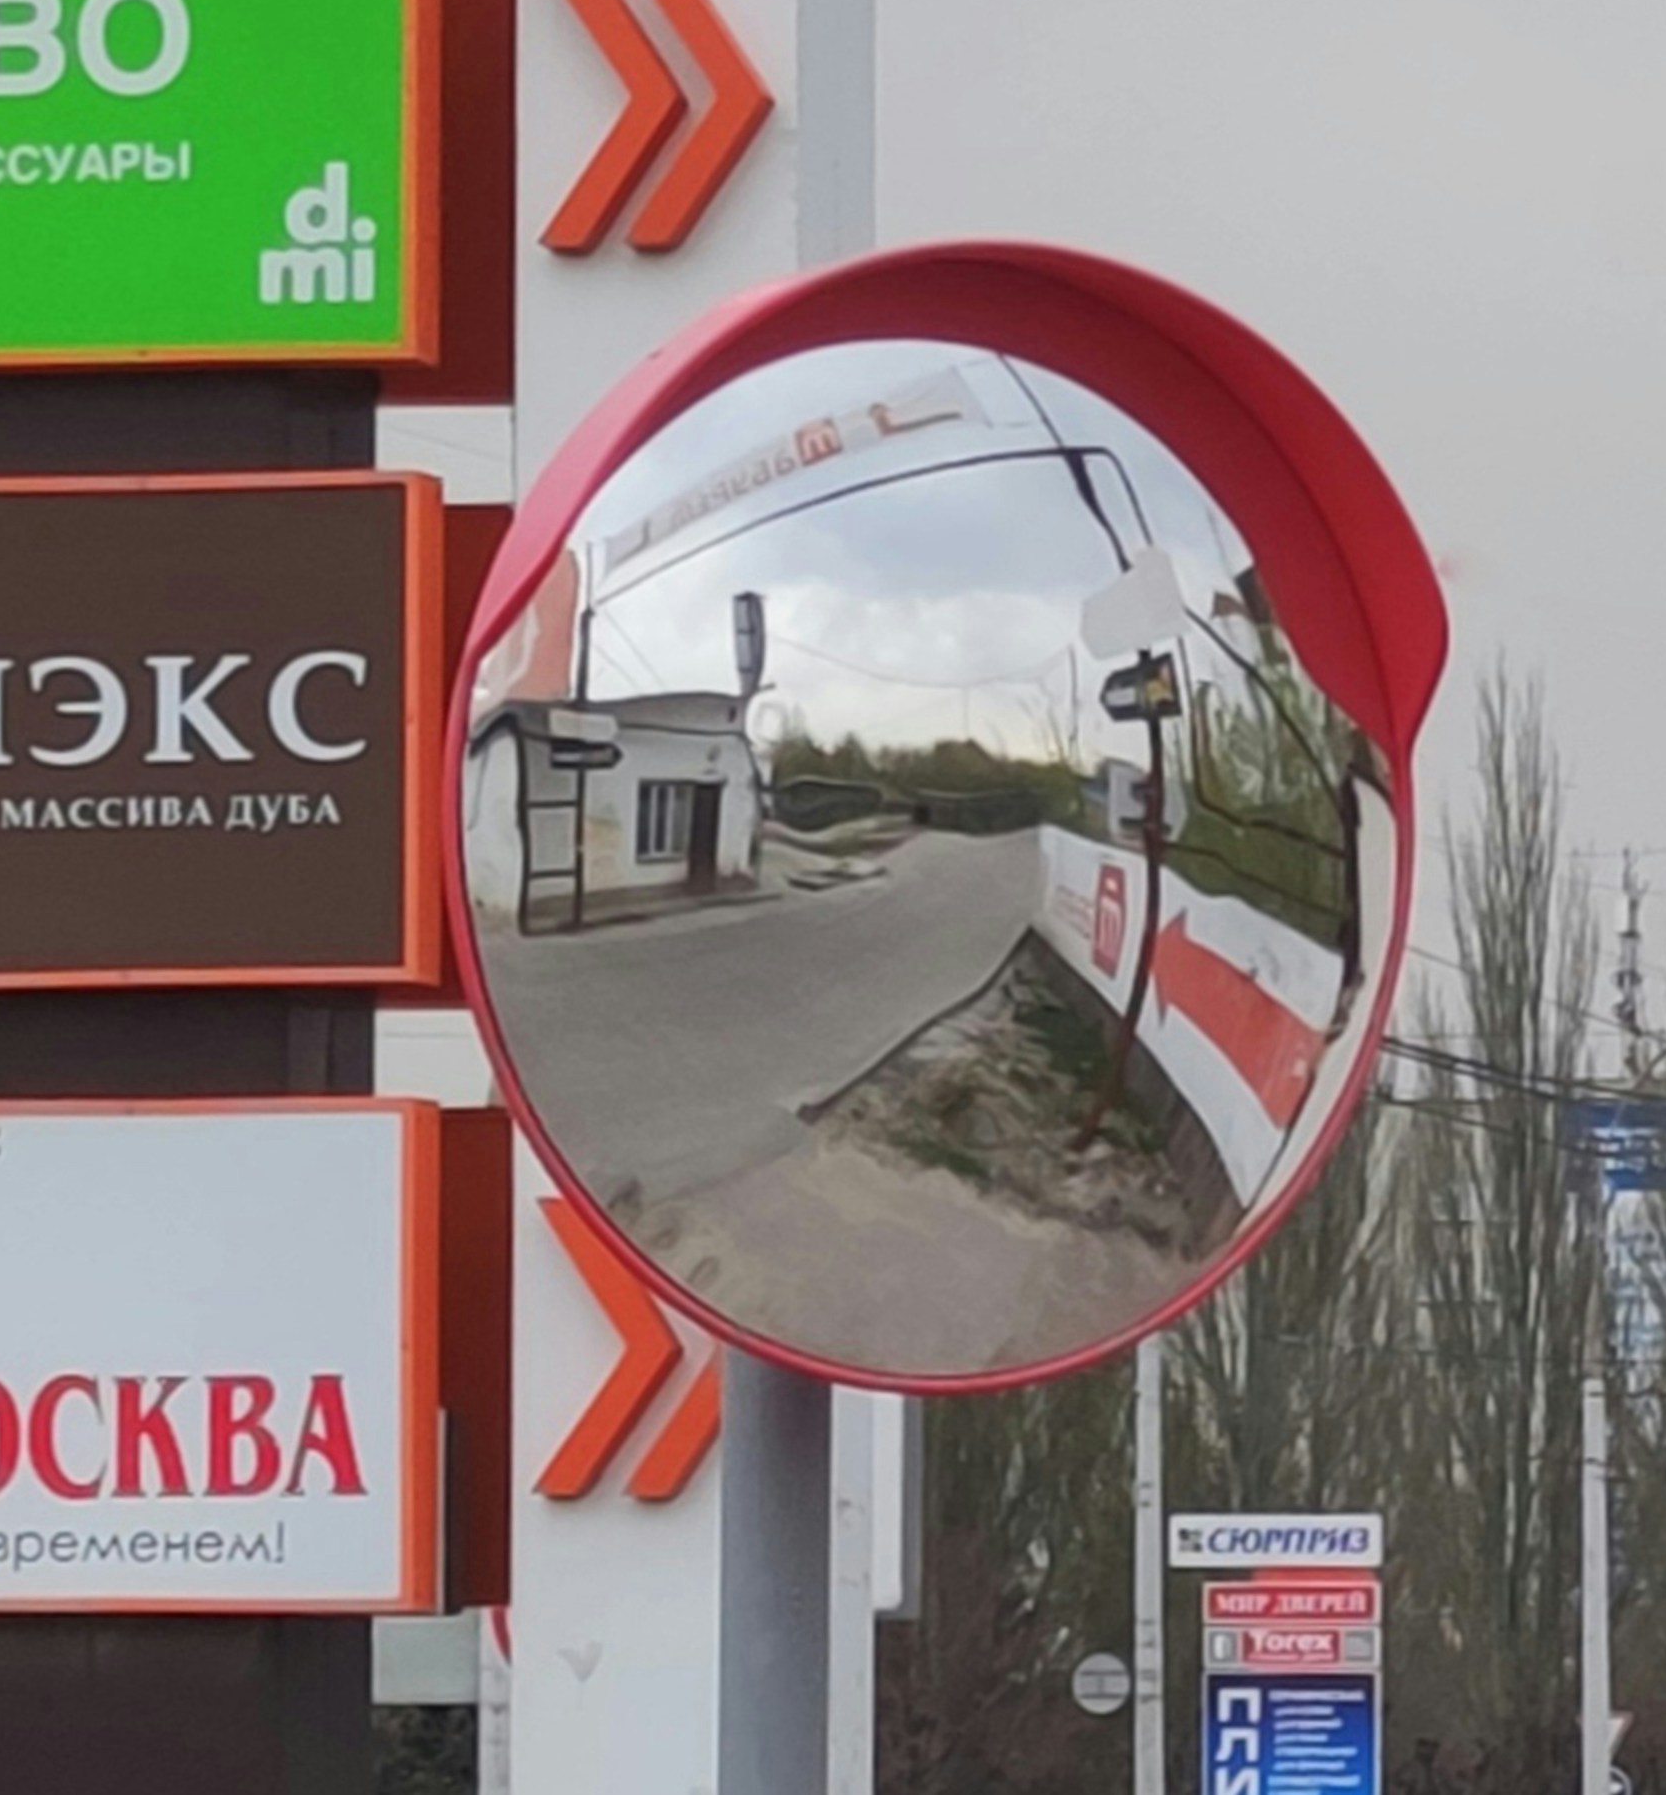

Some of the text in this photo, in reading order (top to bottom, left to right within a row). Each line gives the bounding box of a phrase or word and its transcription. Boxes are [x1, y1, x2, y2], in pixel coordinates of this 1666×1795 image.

[0, 796, 214, 829] МАССИВА
[225, 793, 341, 831] ДУБА
[1206, 1527, 1370, 1554] СЮРПРИЗ
[1247, 1629, 1334, 1653] Torex
